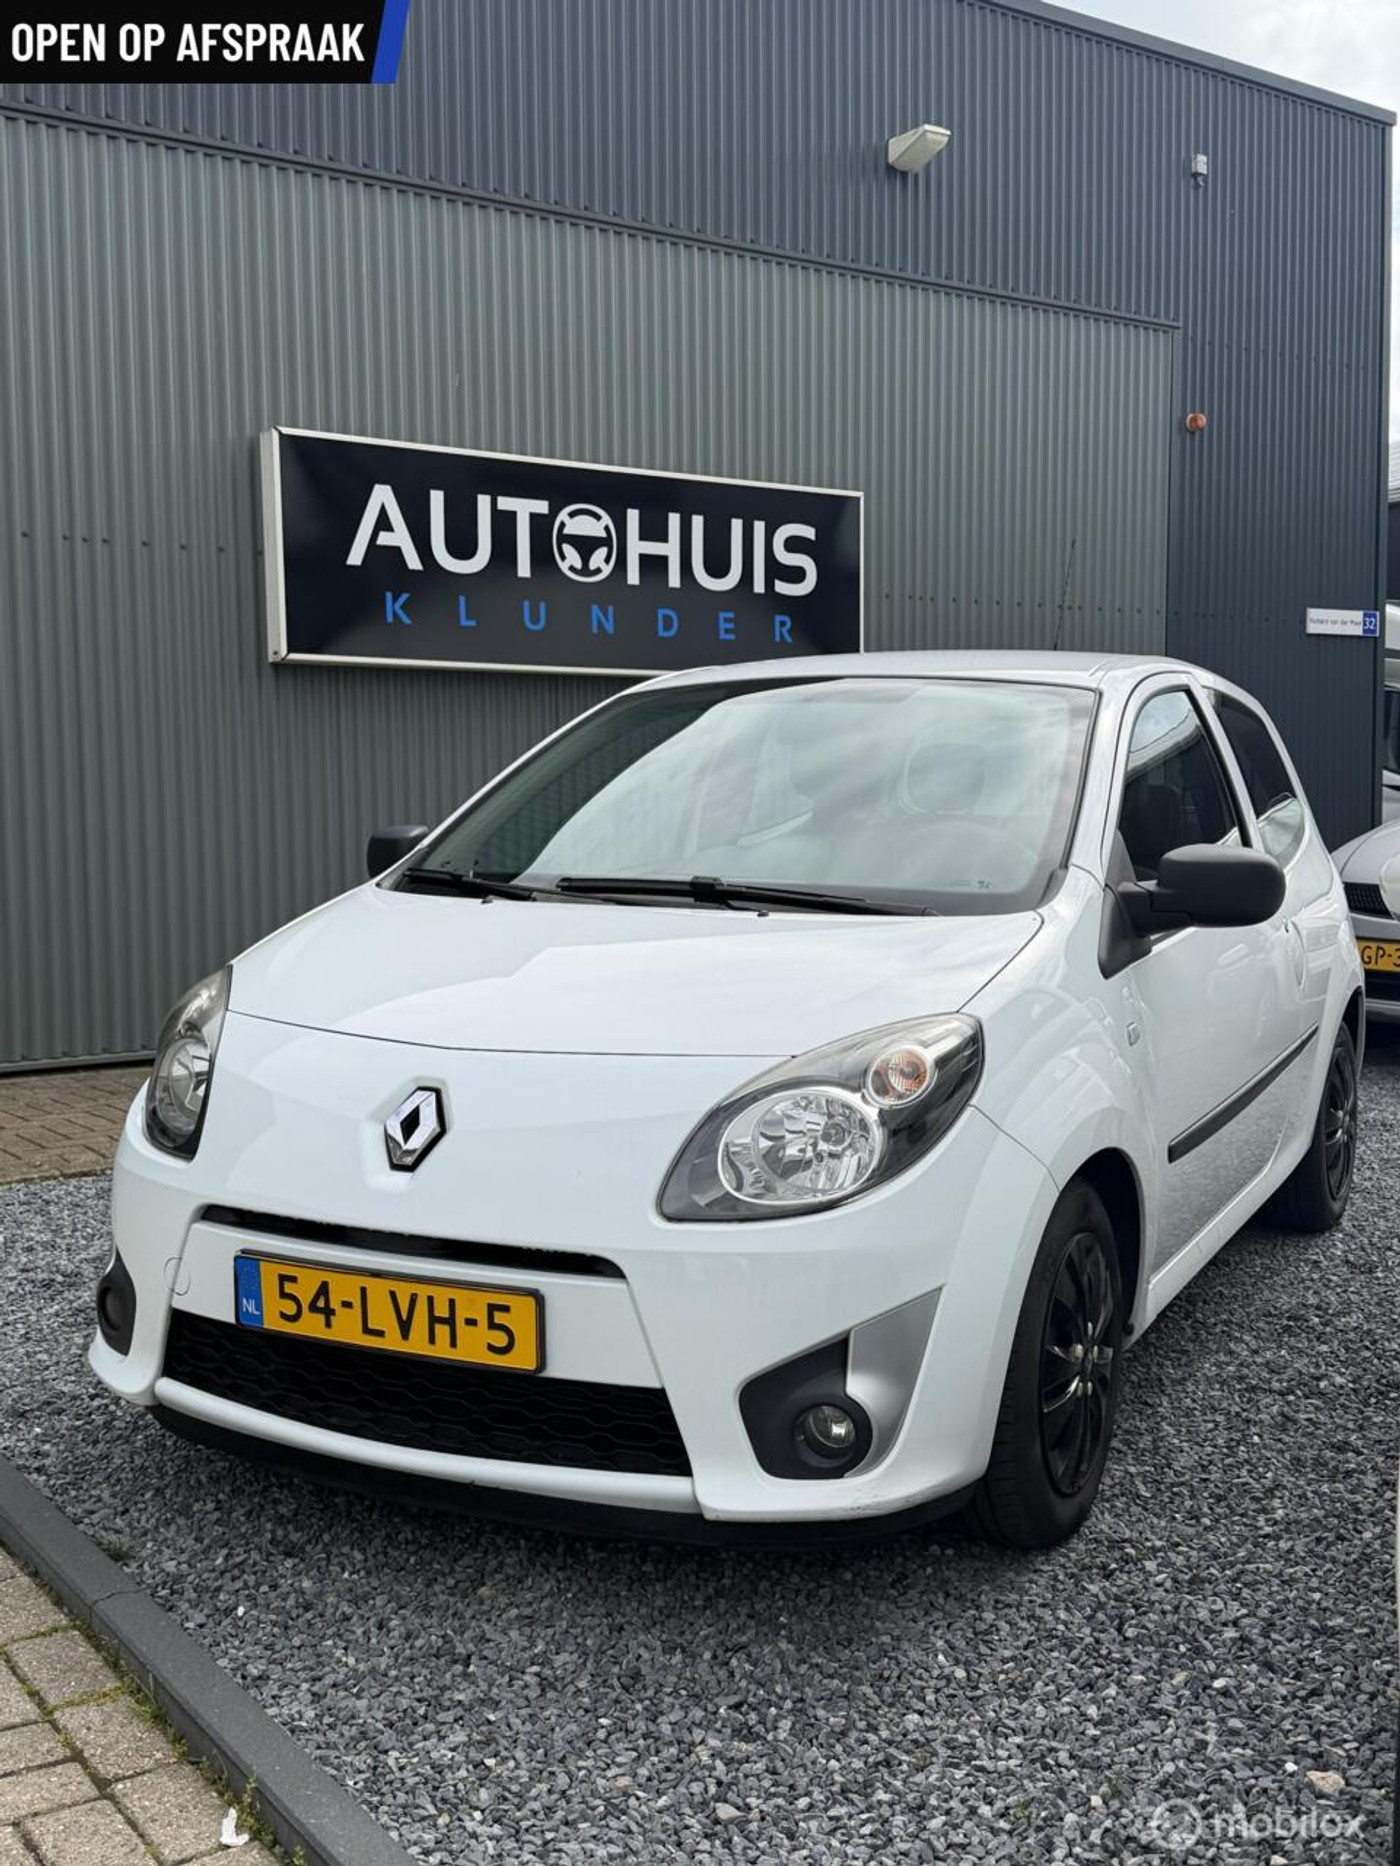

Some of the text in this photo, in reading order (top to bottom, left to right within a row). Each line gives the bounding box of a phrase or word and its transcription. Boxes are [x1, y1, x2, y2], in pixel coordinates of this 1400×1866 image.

[345, 483, 818, 597] AUTOHUIS
[385, 591, 793, 643] KLUNDER
[1363, 618, 1375, 629] 32
[242, 1298, 260, 1315] NL
[277, 1273, 516, 1356] 54-LVH-5
